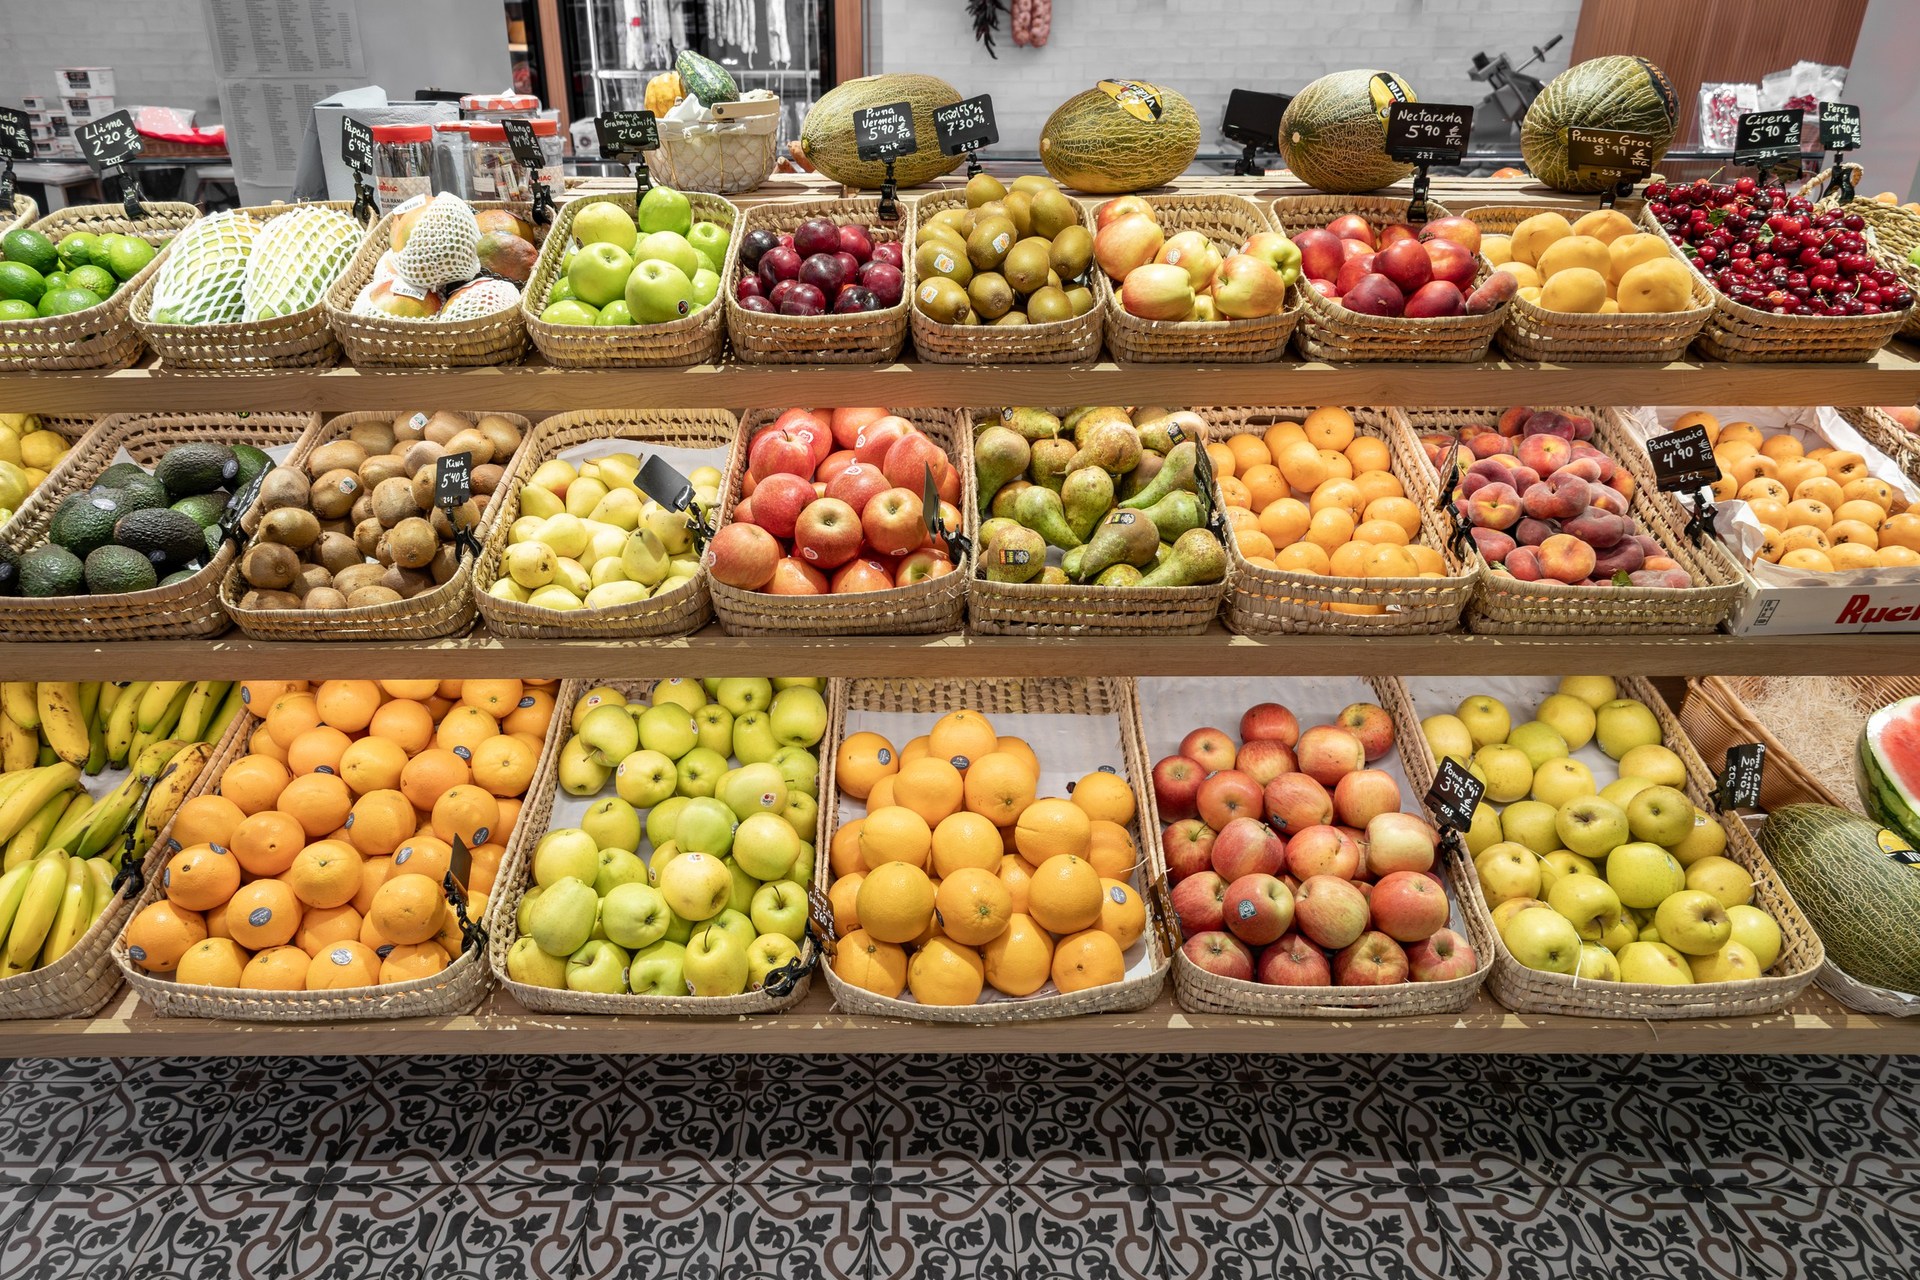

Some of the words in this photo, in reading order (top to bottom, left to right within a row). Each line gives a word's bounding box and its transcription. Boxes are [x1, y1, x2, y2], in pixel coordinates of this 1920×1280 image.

[866, 107, 895, 118] Pruna
[1827, 102, 1849, 114] Peres
[612, 111, 638, 120] Poma
[631, 117, 654, 127] Smith
[862, 115, 906, 128] Vermella
[1396, 109, 1461, 124] Nectarina
[1745, 114, 1791, 125] Cirera
[1821, 112, 1838, 122] Sant
[1841, 115, 1860, 126] Joan
[84, 118, 124, 139] Llima
[344, 117, 370, 143] Papaia
[617, 128, 641, 139] 2'60
[868, 125, 894, 140] 5'90
[1404, 125, 1439, 138] 5'90
[1748, 126, 1780, 143] 5'90
[1829, 123, 1851, 135] 11'90
[92, 132, 120, 156] 2'20
[348, 138, 365, 152] 6'95
[961, 140, 979, 151] 228
[1572, 130, 1611, 145] Pressec
[1619, 135, 1652, 148] Groc
[1832, 140, 1845, 148] 225
[880, 142, 899, 152] 247
[1594, 144, 1626, 157] 8'99
[445, 457, 464, 469] Kiwi
[1663, 446, 1693, 468] 4'90
[441, 472, 460, 488] 5'40
[1680, 471, 1702, 482] 262
[1754, 744, 1765, 769] Poma
[1444, 761, 1464, 784] Poma
[1465, 778, 1480, 797] Fuji
[1440, 776, 1465, 799] 3'95
[1749, 773, 1760, 806] Golden
[1440, 804, 1454, 817] 205
